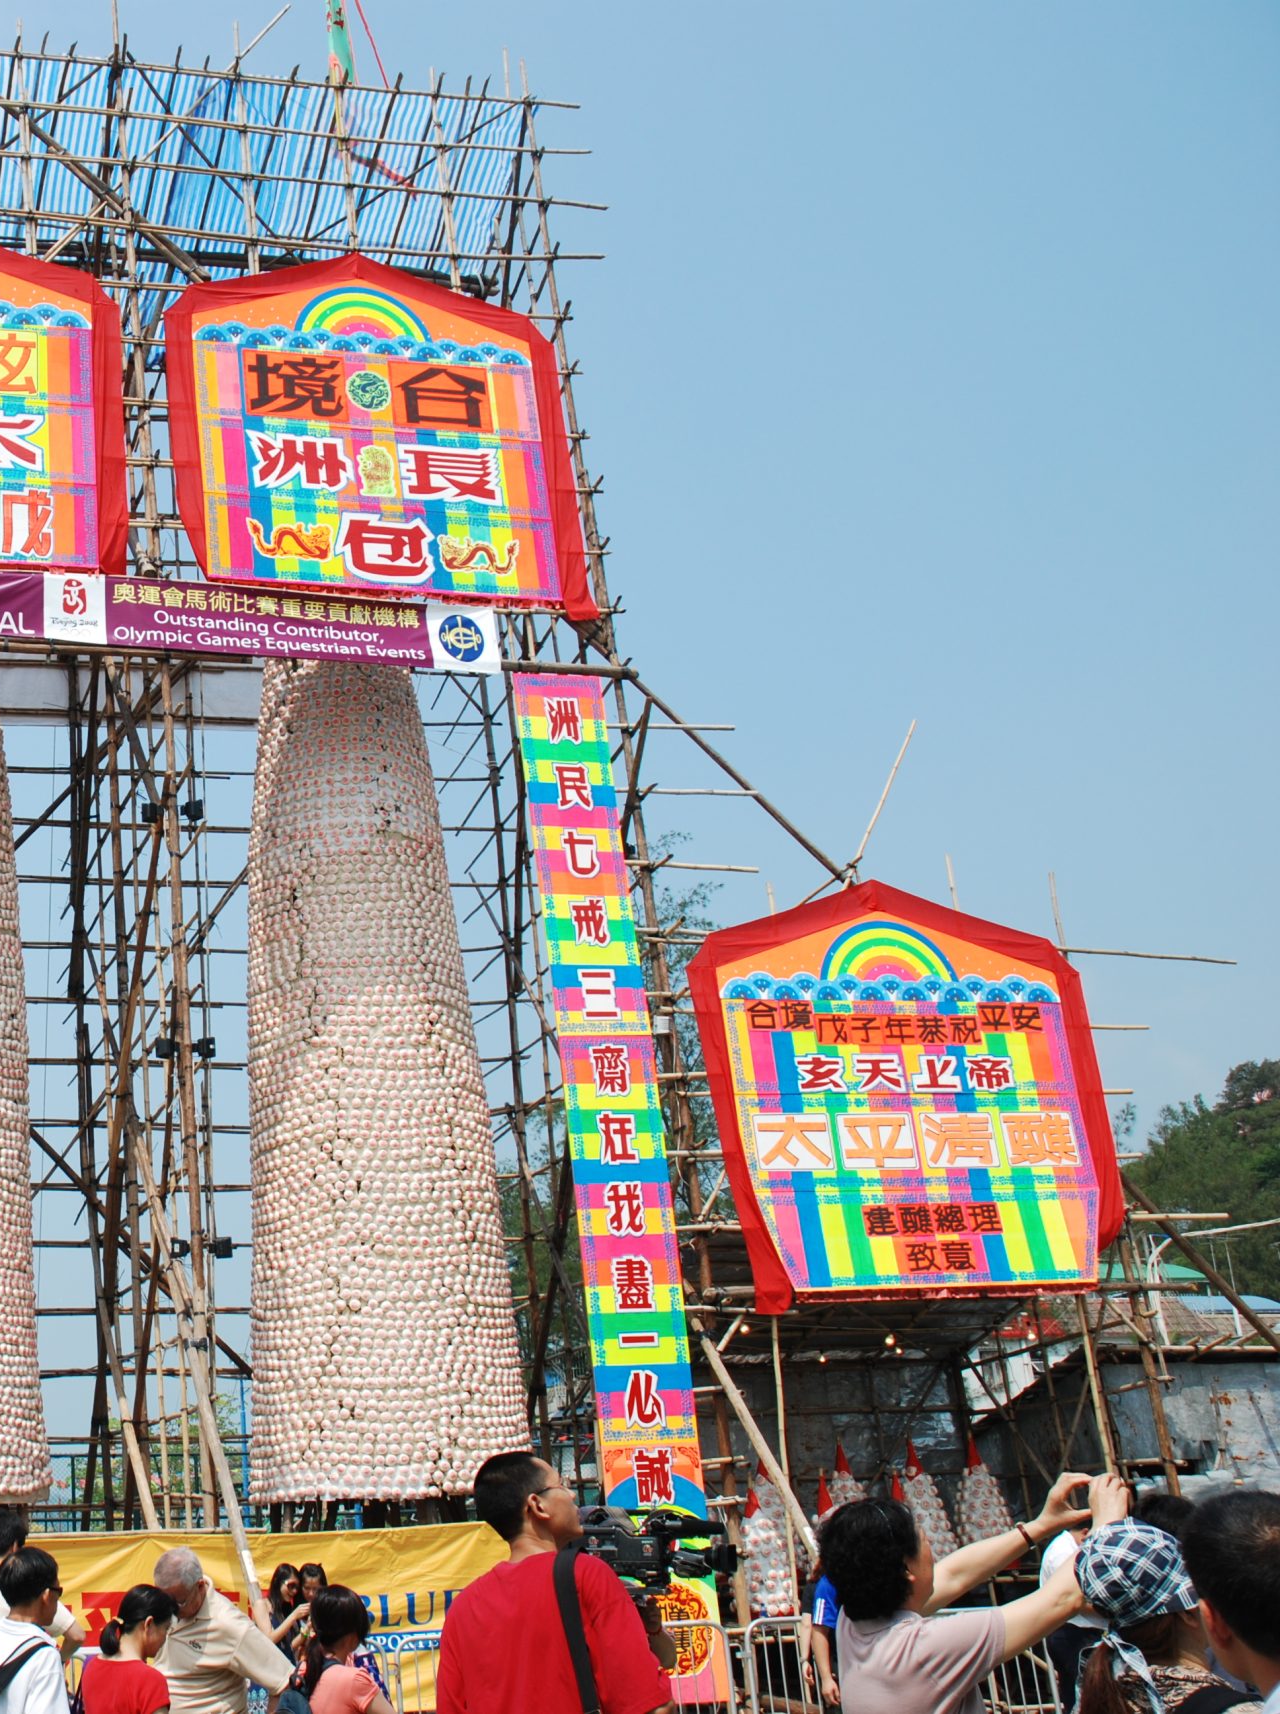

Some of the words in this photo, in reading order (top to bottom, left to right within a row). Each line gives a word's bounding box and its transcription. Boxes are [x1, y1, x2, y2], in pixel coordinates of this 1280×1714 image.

[340, 516, 431, 579] 包
[113, 625, 194, 647] Olympic
[197, 632, 262, 650] Games
[265, 637, 362, 657] Equestrian
[366, 645, 426, 661] Events
[153, 609, 269, 637] Outstanding
[273, 620, 385, 645] Contributor,
[797, 1056, 1011, 1090] 玄天上帝
[907, 1243, 977, 1271] 致意
